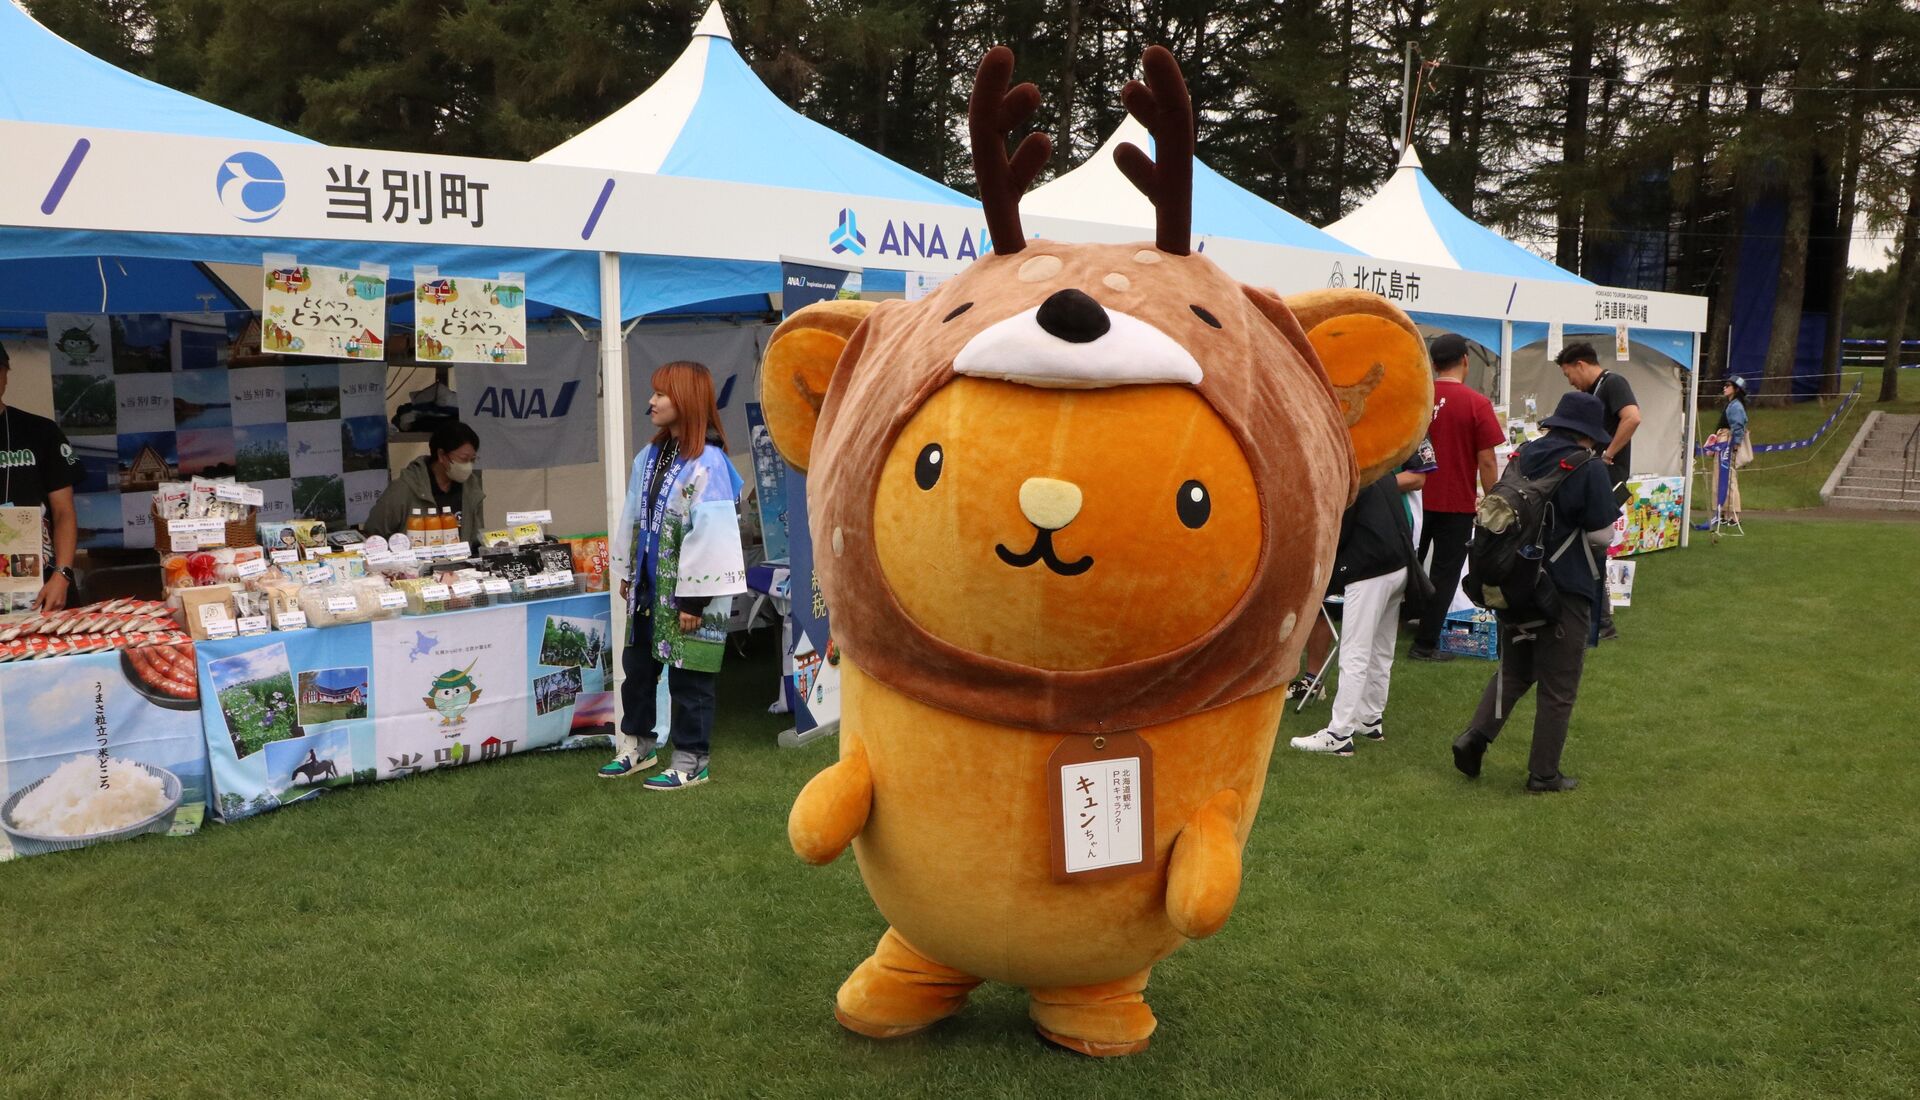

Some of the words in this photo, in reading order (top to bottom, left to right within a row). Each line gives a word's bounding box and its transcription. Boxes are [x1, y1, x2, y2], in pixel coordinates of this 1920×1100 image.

[325, 164, 489, 228] 当別町
[878, 219, 949, 260] ANA
[786, 276, 800, 287] ANA
[1353, 265, 1421, 302] 北広島市
[291, 307, 364, 329] とうべつ。
[441, 318, 507, 337] とうべつ。
[473, 386, 548, 419] ANA
[94, 681, 111, 790] うまさ粒立つ米どころ
[1112, 770, 1122, 833] PRキャラクター
[1122, 768, 1132, 811] 北海道観光
[1075, 775, 1099, 859] キュンちゃん
